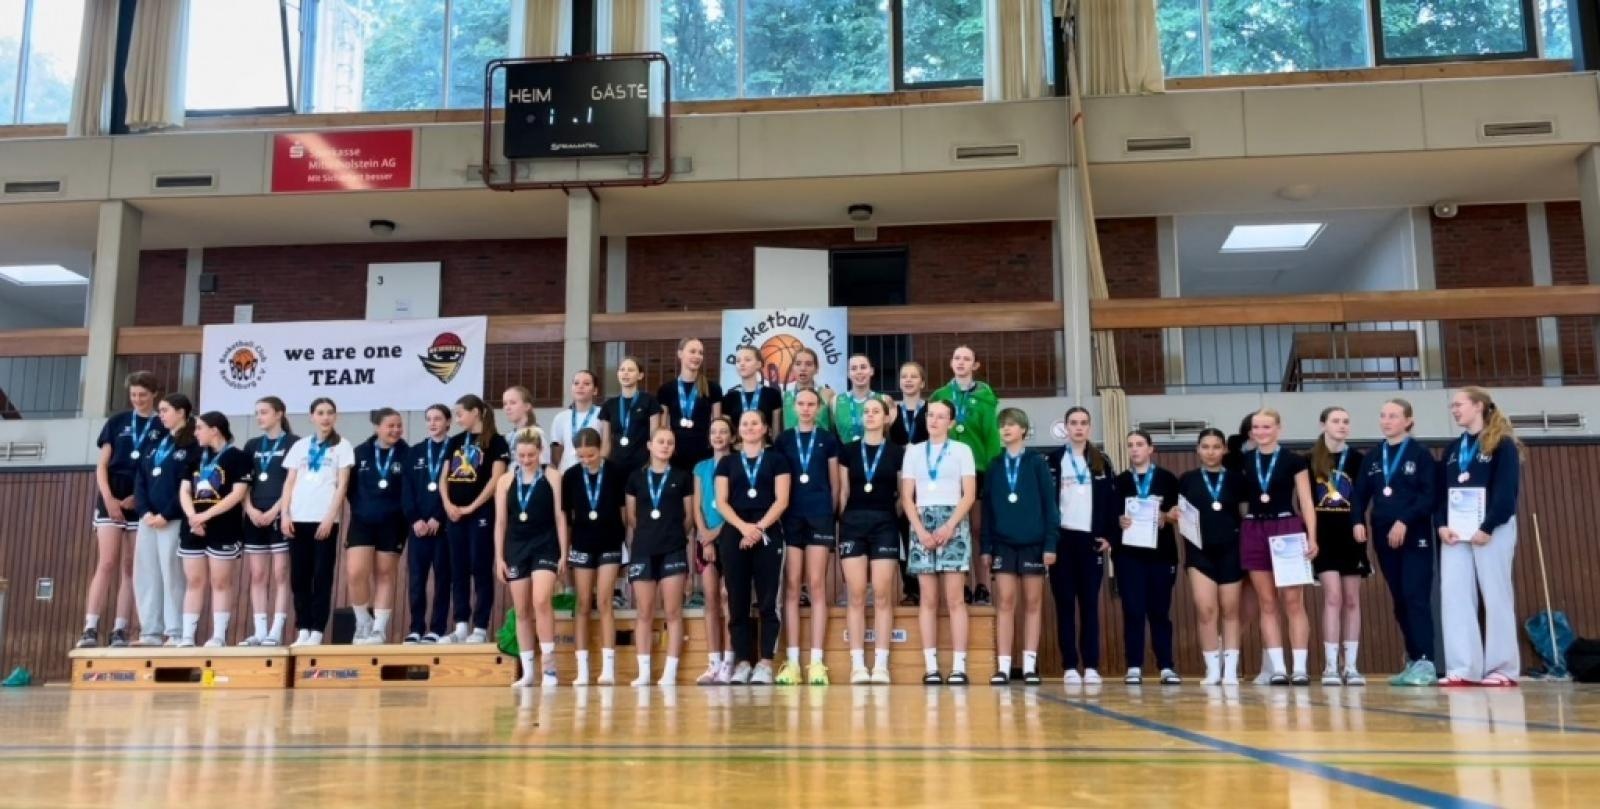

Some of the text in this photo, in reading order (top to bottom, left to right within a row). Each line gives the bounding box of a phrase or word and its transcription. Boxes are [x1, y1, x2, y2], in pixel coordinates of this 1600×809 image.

[509, 88, 552, 103] HEIM
[380, 158, 397, 168] AG
[376, 275, 384, 286] 3
[283, 344, 403, 361] we are one
[308, 367, 376, 386] TEAM
